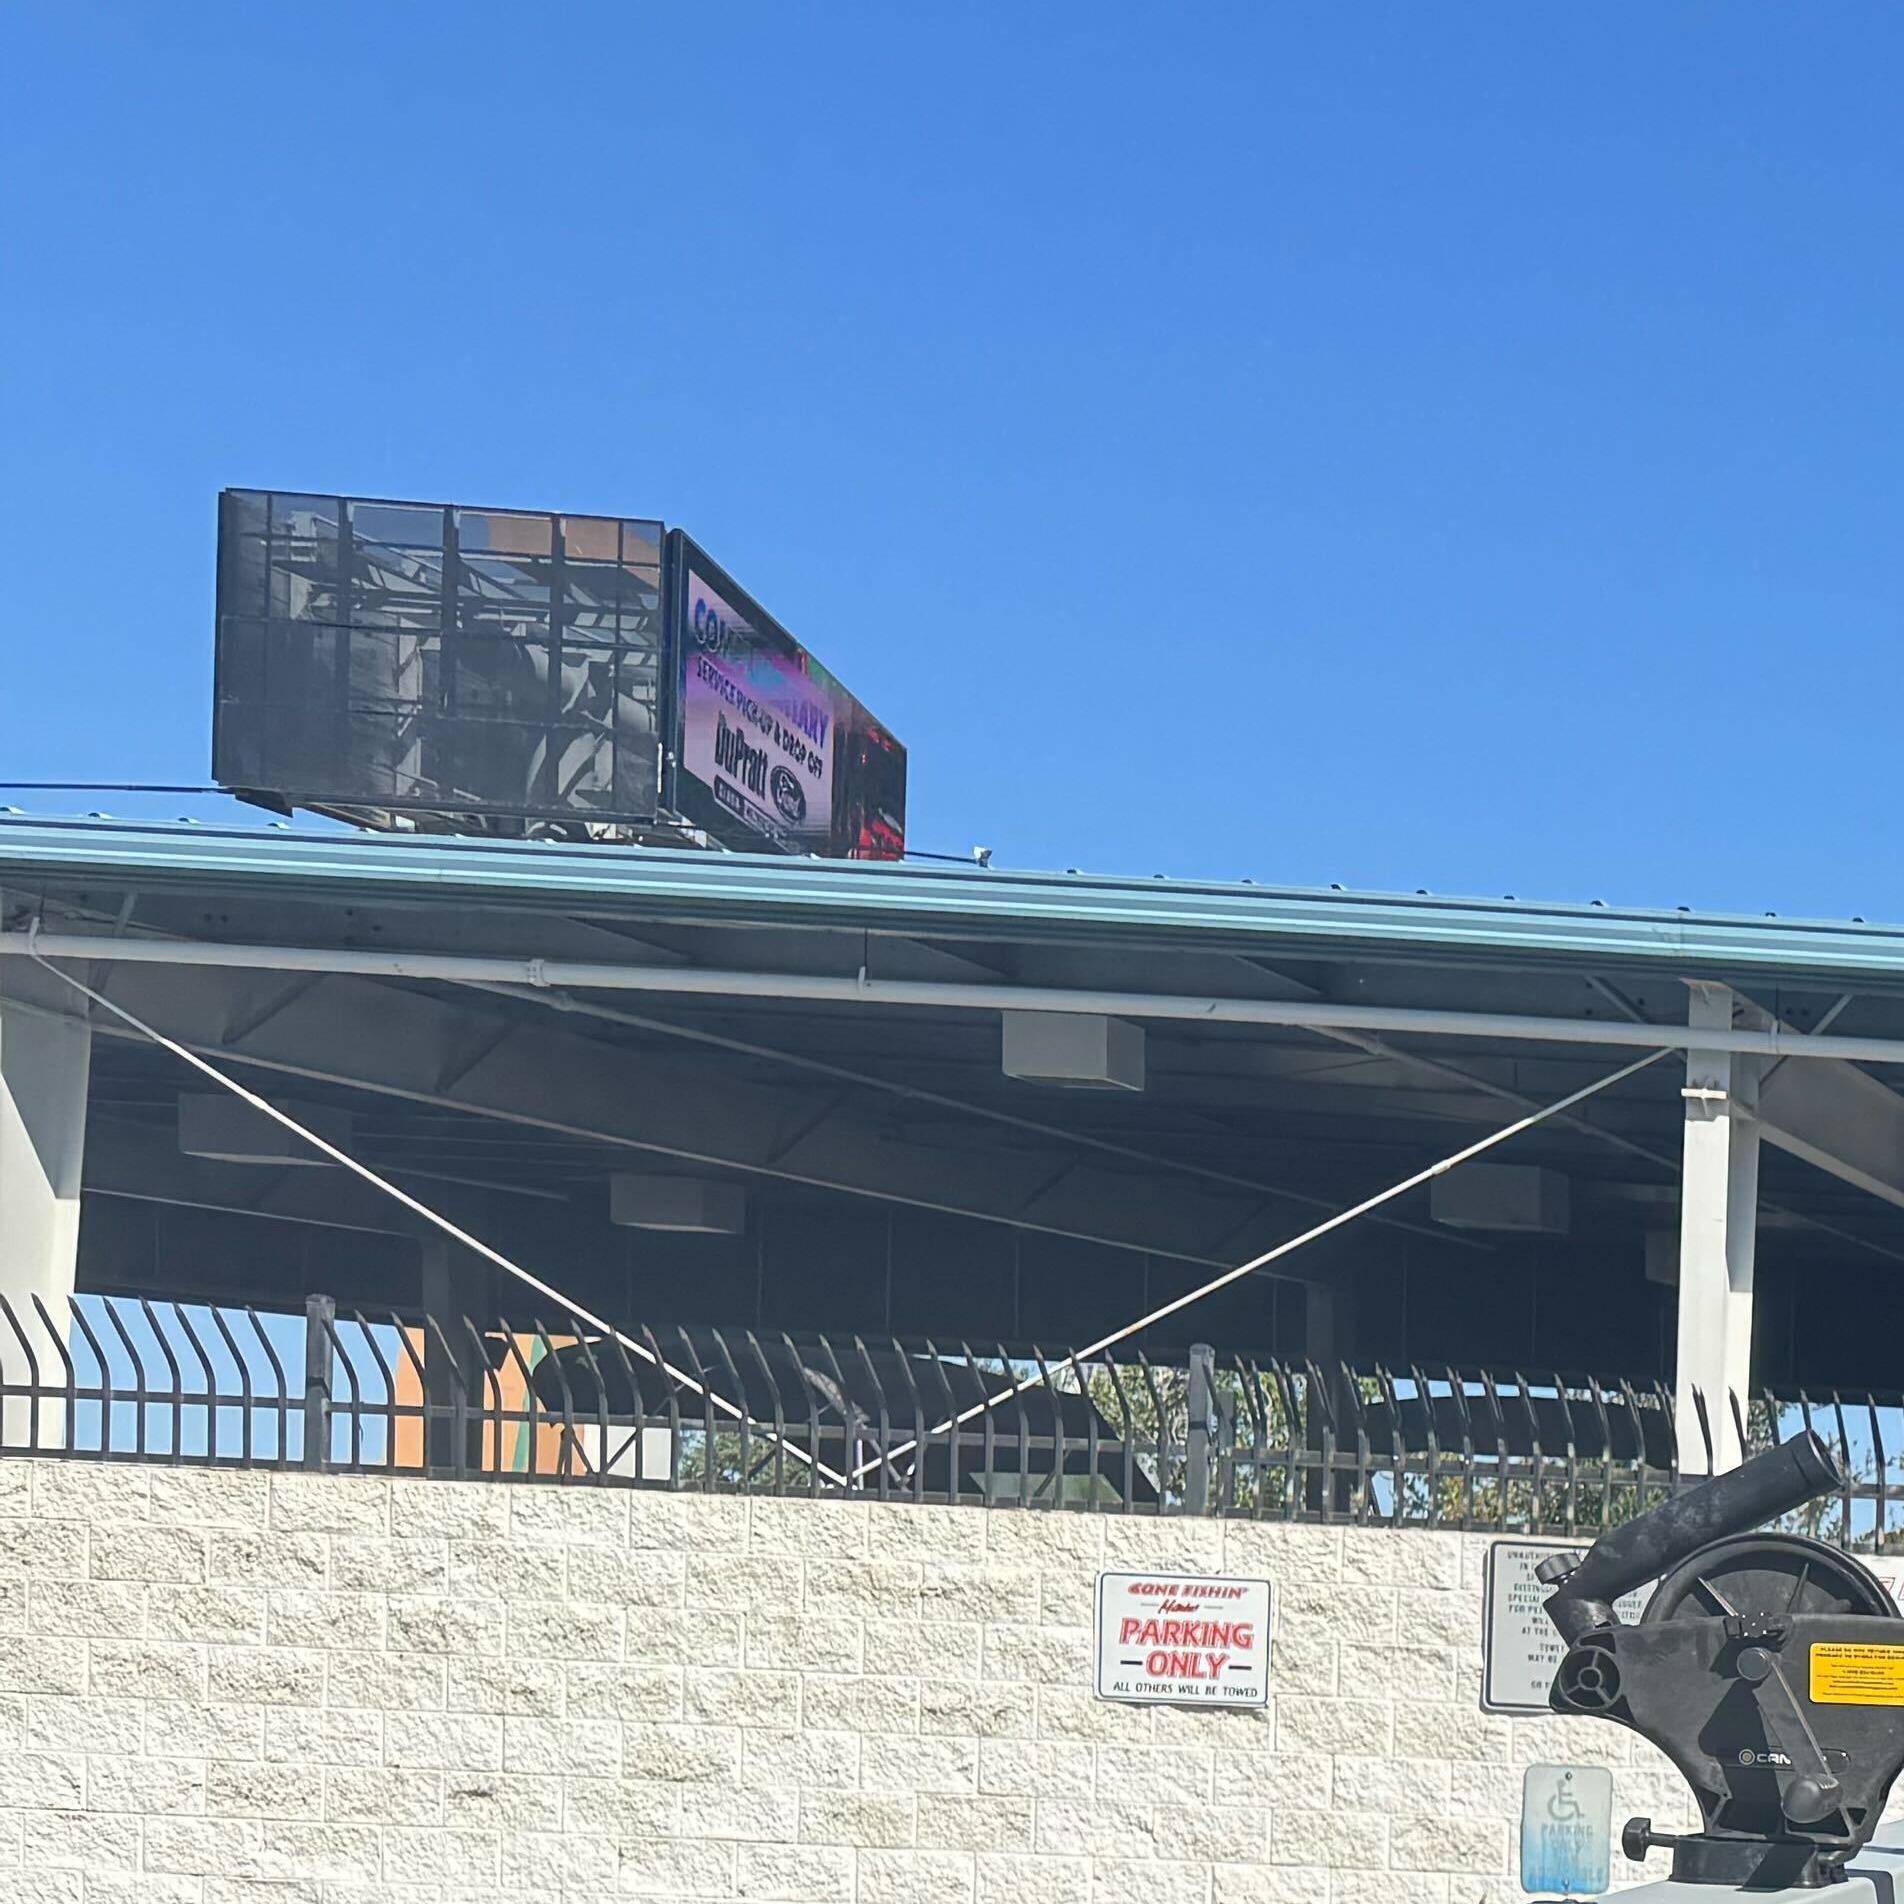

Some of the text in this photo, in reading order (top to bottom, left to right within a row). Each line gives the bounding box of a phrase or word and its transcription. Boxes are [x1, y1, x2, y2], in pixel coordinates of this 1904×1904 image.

[714, 709, 769, 801] DuPratt
[1127, 1582, 1180, 1597] GONE
[1119, 1617, 1255, 1650] PARKING
[1145, 1650, 1230, 1681] ONLY
[1113, 1681, 1258, 1698] ALL OTHERS WILL BE TOWED
[1541, 1823, 1593, 1838] PARKING
